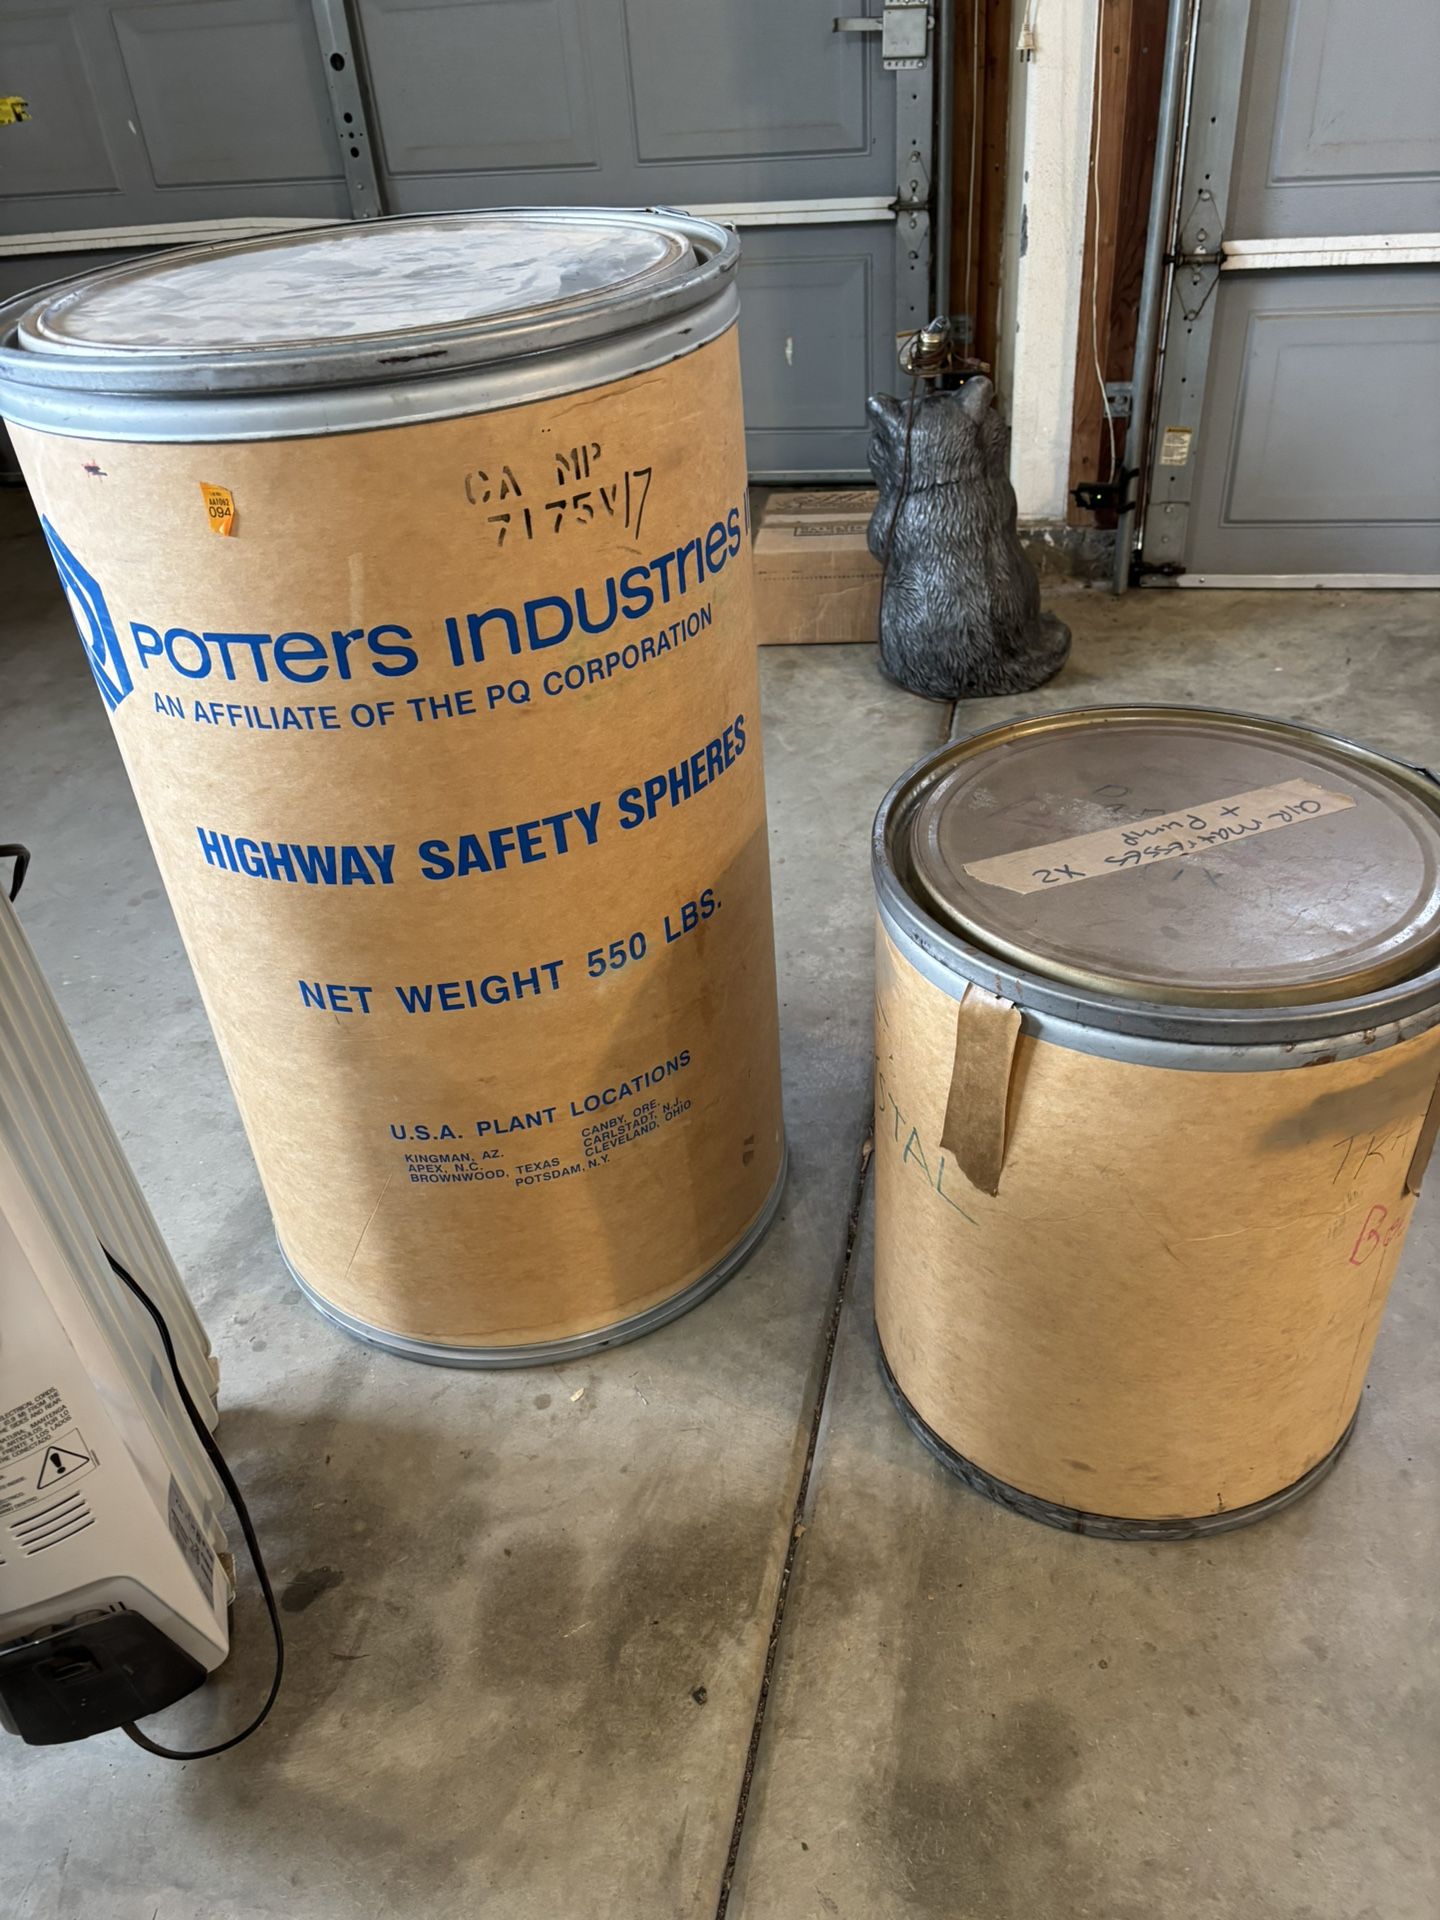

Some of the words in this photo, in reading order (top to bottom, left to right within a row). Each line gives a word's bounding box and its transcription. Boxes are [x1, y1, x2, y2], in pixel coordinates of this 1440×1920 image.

[465, 465, 522, 504] CA
[555, 442, 602, 486] MP
[154, 691, 185, 720] AN
[194, 700, 341, 730] AFFILIATE
[350, 701, 395, 728] OF
[406, 689, 477, 722] THE
[486, 679, 531, 710] PQ
[543, 602, 712, 696] CORPORATION
[196, 825, 396, 886] HIGHWAY
[418, 802, 602, 881] SAFETY
[619, 713, 747, 831] SPHERES
[298, 979, 374, 1015] NET
[395, 959, 564, 1015] WEIGHT
[586, 931, 647, 979] 550
[663, 887, 722, 944] LBS.
[390, 1123, 464, 1142] U.S.A.
[476, 1106, 557, 1138] PLANT
[570, 1048, 692, 1118] LOCATIONS
[633, 1099, 661, 1118] ORE.
[664, 1099, 693, 1123] OHIO
[454, 1161, 484, 1174] N.C.
[516, 1157, 561, 1175] TEXAS
[587, 1153, 611, 1169] N.Y.
[35, 1428, 50, 1440] LOS
